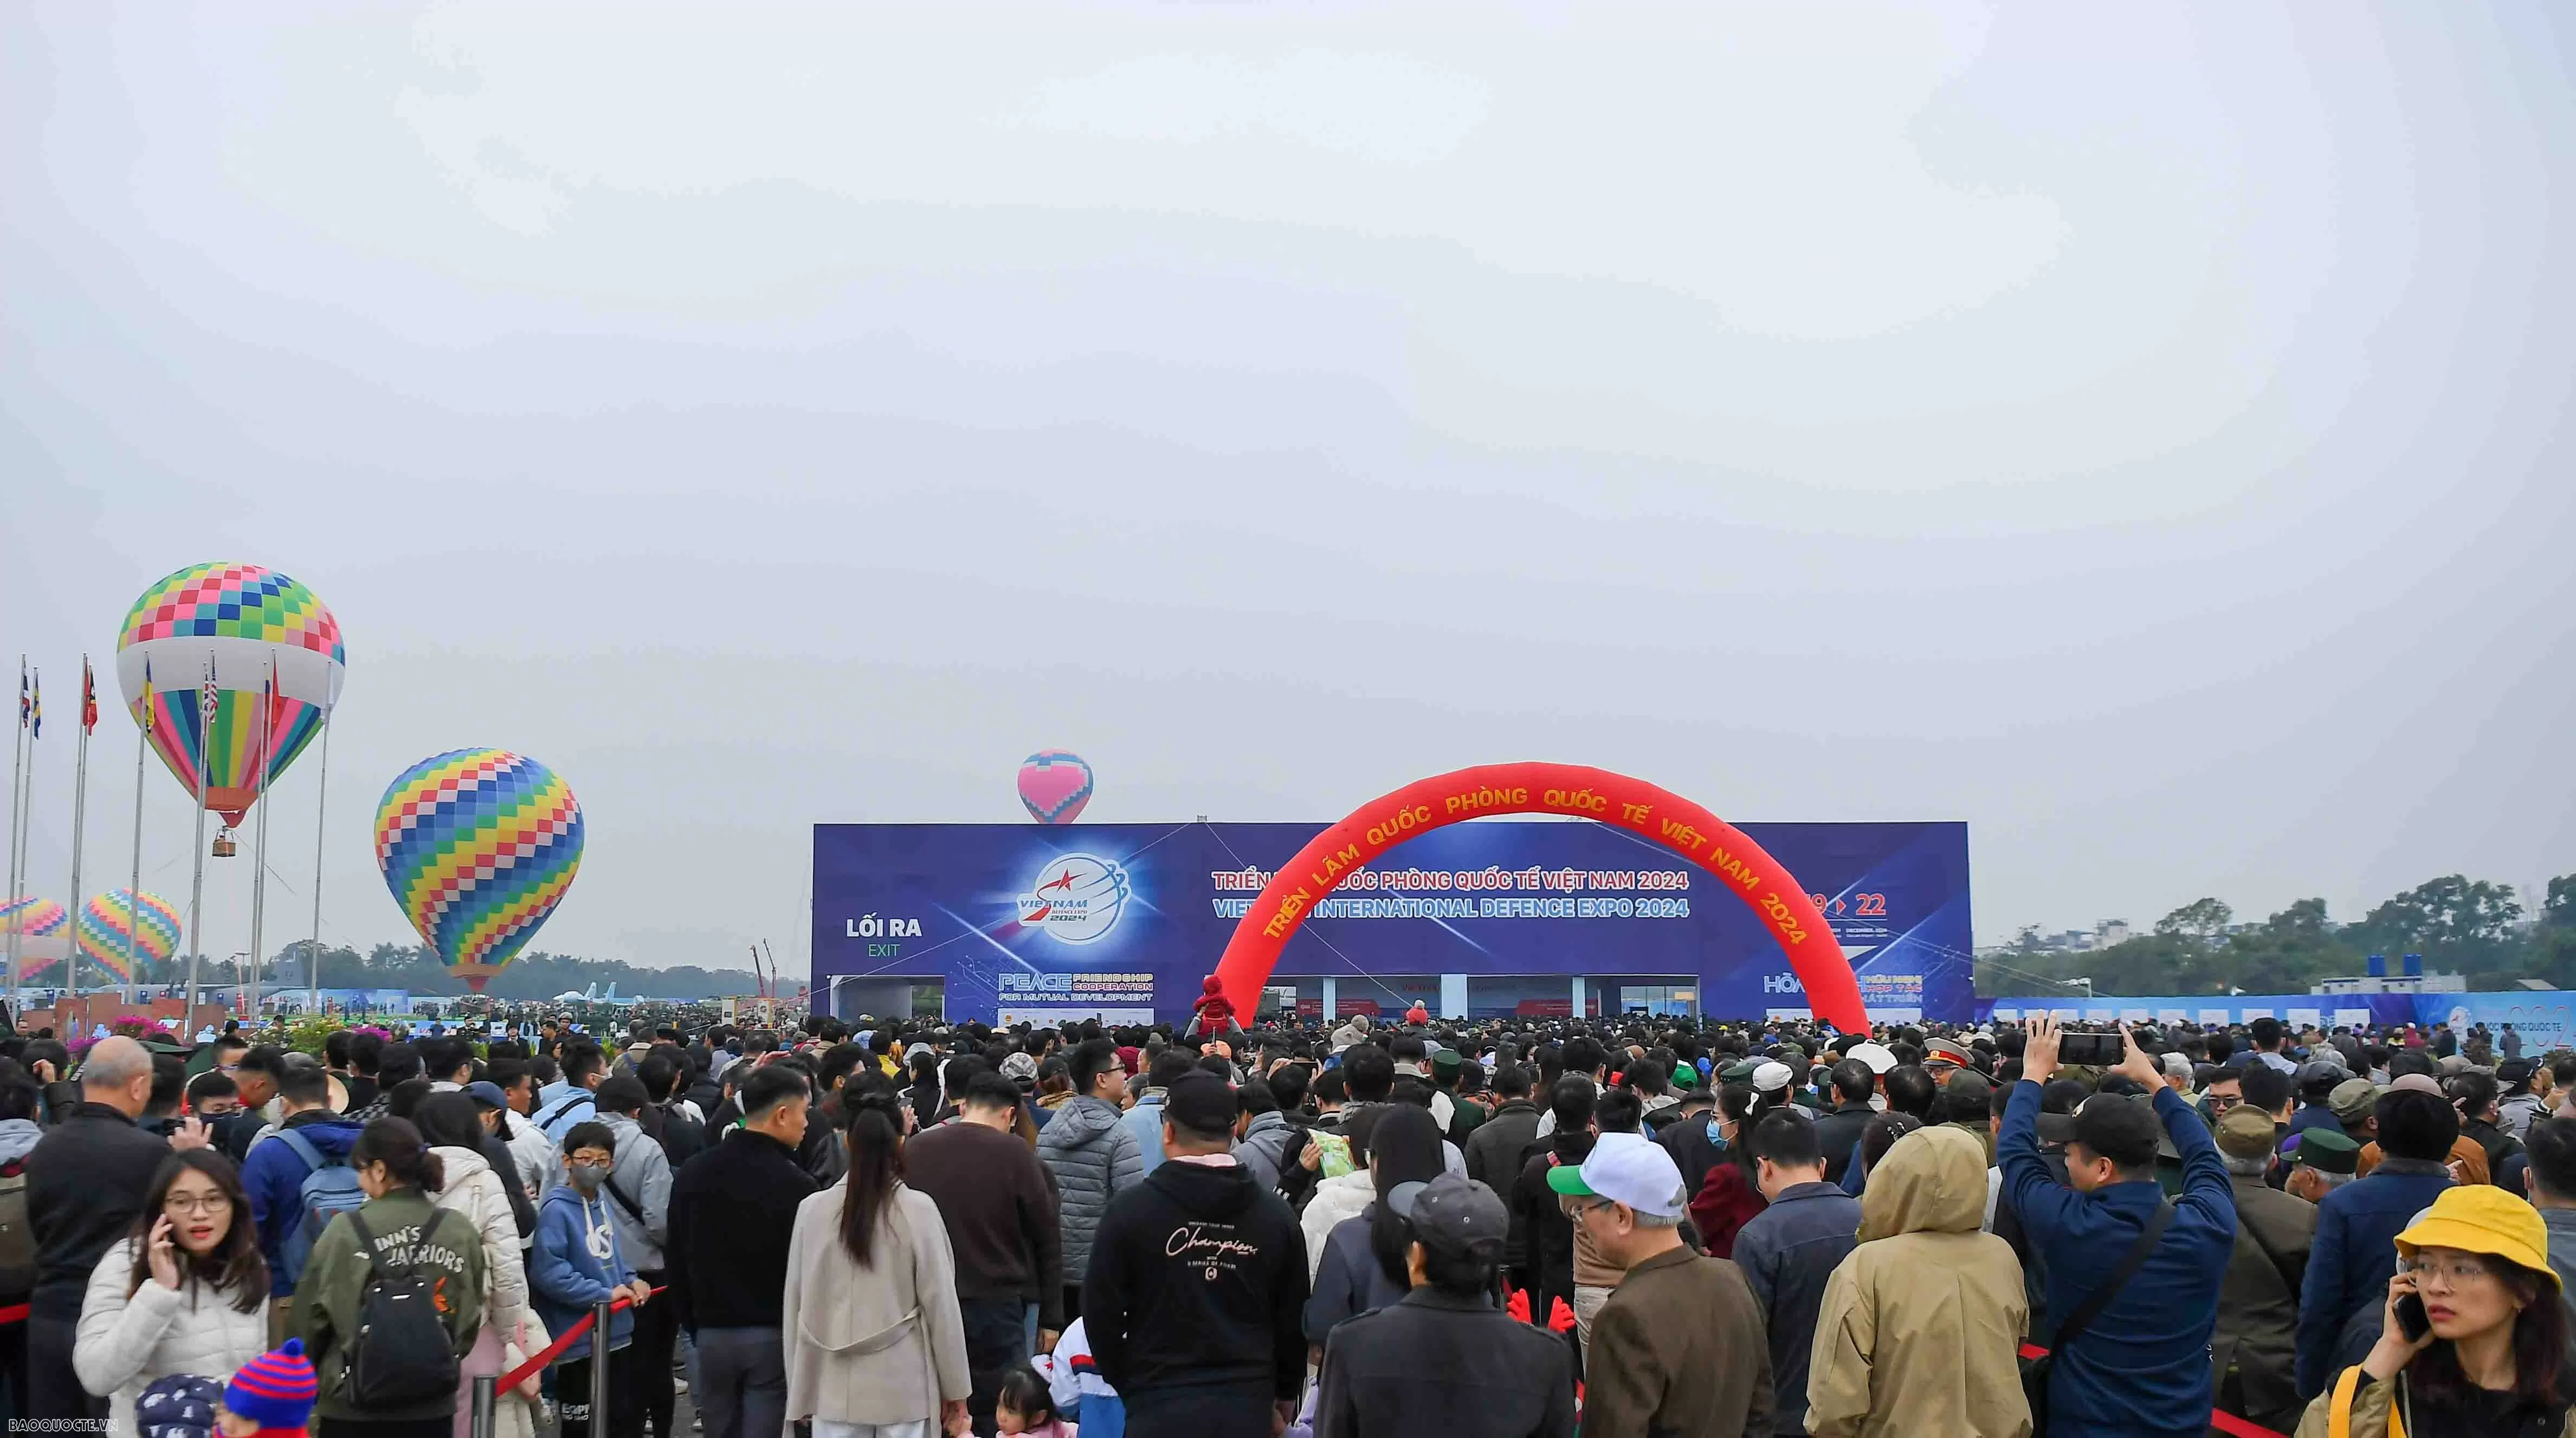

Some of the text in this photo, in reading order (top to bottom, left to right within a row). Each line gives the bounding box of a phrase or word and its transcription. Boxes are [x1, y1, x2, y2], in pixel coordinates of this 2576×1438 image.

[1366, 804, 1431, 845] QUỐC
[1445, 785, 1527, 814] PHÒNG
[1544, 788, 1607, 812] QUỐC
[1622, 802, 1654, 825] TẾ
[1661, 818, 1707, 850] VIỆT
[1709, 847, 1760, 890] NAM
[1760, 893, 1807, 945] 2024
[1331, 866, 1378, 892] UỐC
[1380, 867, 1452, 890] PHÒNG
[1454, 865, 1513, 892] QUỐC
[1514, 865, 1541, 890] TẾ
[1542, 867, 1586, 893] VIỆT
[1589, 871, 1635, 890] NAM
[1637, 871, 1690, 891] 2024
[1314, 897, 1479, 918] INTERNATIONAL
[1480, 897, 1576, 918] DEFENCE
[1577, 897, 1634, 918] EXPO
[1636, 897, 1690, 918] 2024
[1807, 893, 1887, 916] 9 22
[847, 912, 922, 937] LỐI RA
[868, 944, 901, 957] EXIT
[998, 973, 1153, 991] PEACE FRIENDSHIP
[1073, 983, 1153, 991] COOPERATION
[998, 993, 1153, 1001] FOR MUTUAL DEVELOPMENT
